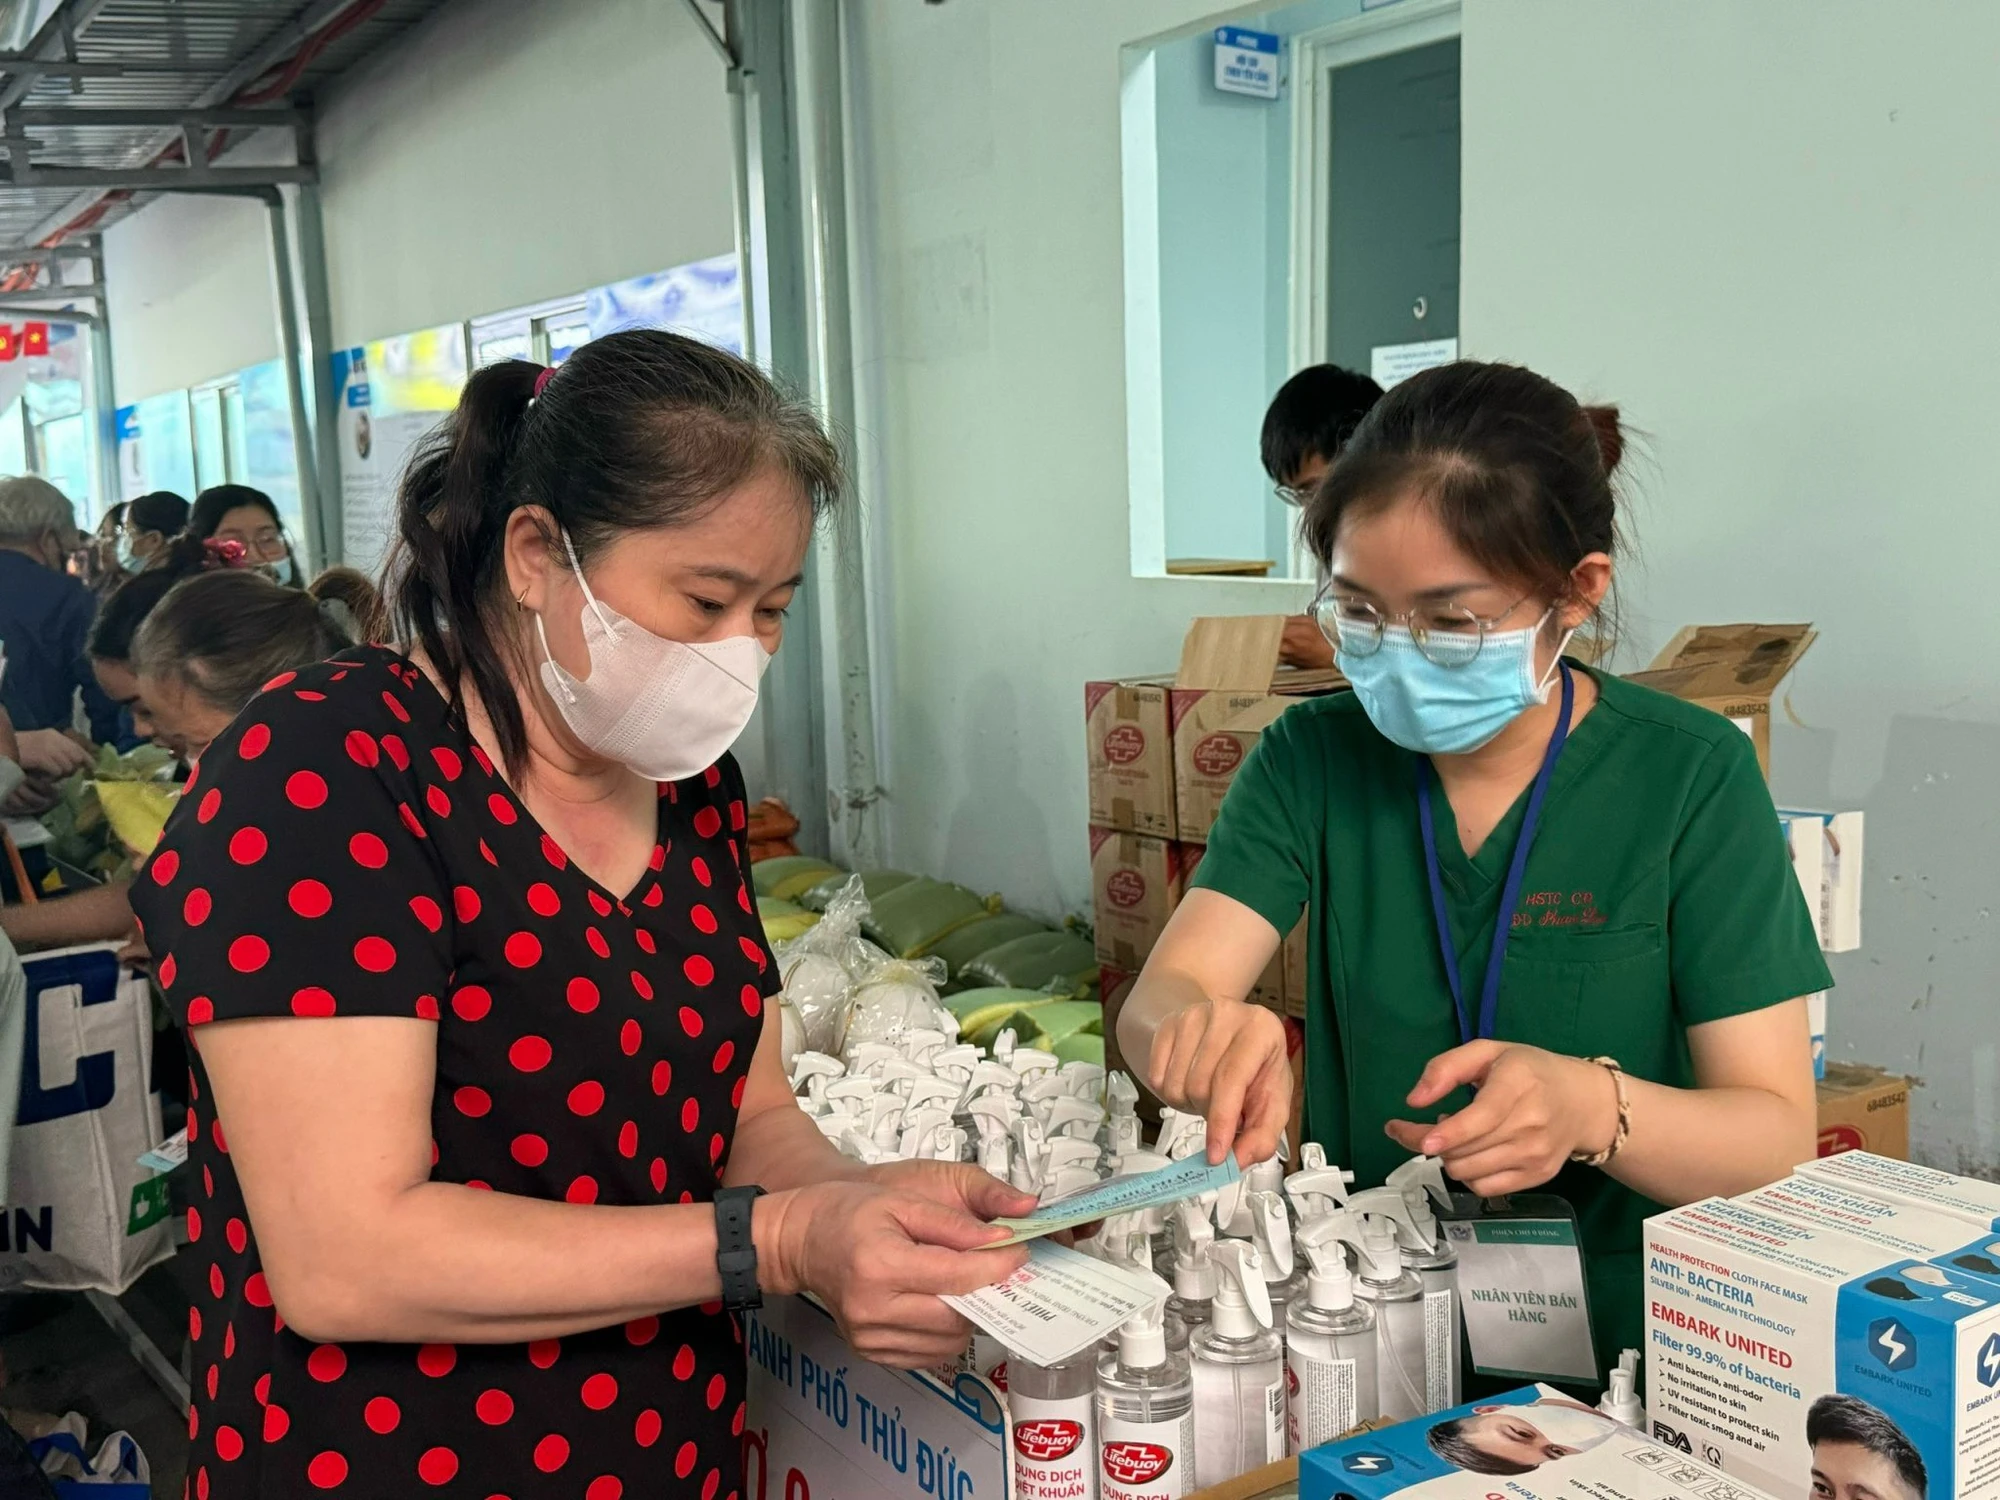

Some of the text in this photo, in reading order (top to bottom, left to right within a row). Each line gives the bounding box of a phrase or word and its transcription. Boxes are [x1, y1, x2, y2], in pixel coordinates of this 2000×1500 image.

[1761, 1189, 1872, 1225] EMBARK UNITED
[1782, 1181, 1843, 1200] KHÁNG
[1678, 1210, 1789, 1247] EMBARK UNITED
[1700, 1202, 1760, 1222] KHÁNG
[1650, 1242, 1808, 1304] HEALTH PROTECTION CLOTH FACE MASK
[1651, 1257, 1754, 1307] ANTI- BACTERIA
[1014, 1297, 1057, 1323] PHIẾU
[1472, 1288, 1577, 1309] NHÂN VIÊN BÁN
[1508, 1307, 1547, 1324] HÀNG
[1650, 1276, 1674, 1292] SILVER
[1676, 1286, 1690, 1298] ION
[1696, 1293, 1738, 1316] AMERICAN
[1739, 1308, 1796, 1336] TECHNOLOGY
[1652, 1301, 1793, 1368] EMBARK UNITED
[1652, 1328, 1801, 1400] Filter 99.9% of bacteria
[1667, 1357, 1764, 1402] Anti bacteria, anti-odor
[1854, 1364, 1932, 1398] EMBARK UNITED
[747, 1310, 793, 1387] ÀNH
[800, 1352, 850, 1428] PHỐ
[856, 1394, 908, 1474] THỦ
[1667, 1372, 1747, 1412] No irritation to skin
[1966, 1393, 1992, 1412] EMBARK
[1667, 1388, 1780, 1442] UV resistant to protect skin
[1668, 1404, 1765, 1452] Filter toxic smog and air
[1016, 1428, 1077, 1446] Lifebuoy
[1654, 1420, 1692, 1455] FDA
[1050, 1468, 1082, 1484] DỊCH
[1104, 1448, 1164, 1471] Lifebuoy
[1038, 1483, 1085, 1500] KHUẨN
[1103, 1482, 1134, 1500] DUNG
